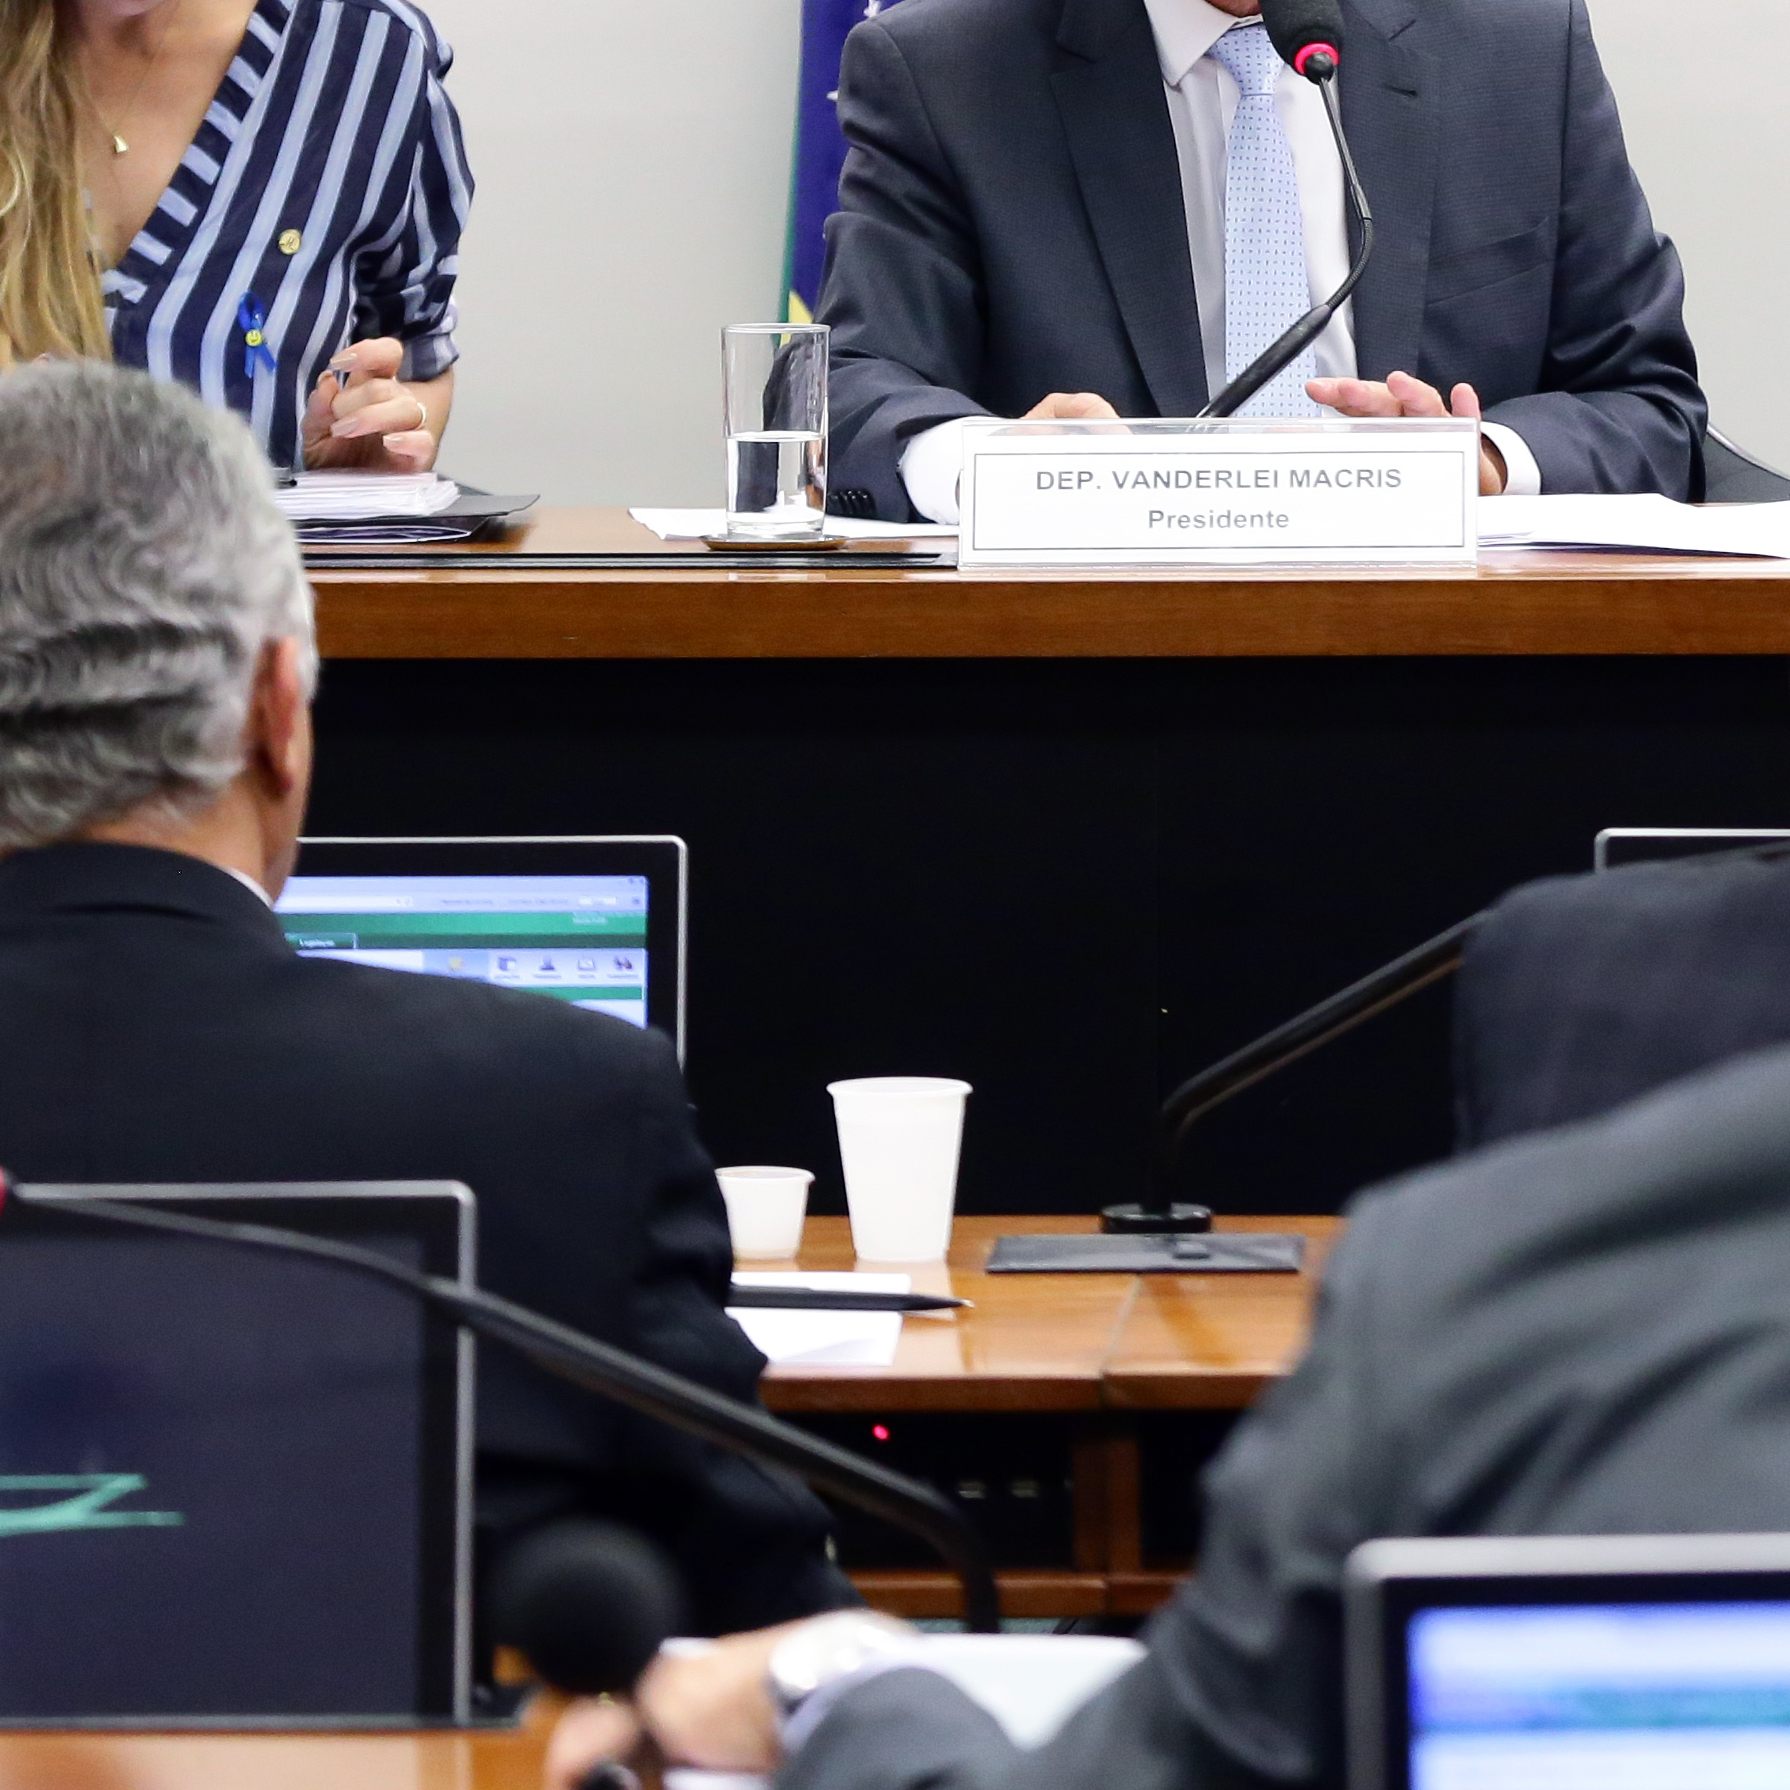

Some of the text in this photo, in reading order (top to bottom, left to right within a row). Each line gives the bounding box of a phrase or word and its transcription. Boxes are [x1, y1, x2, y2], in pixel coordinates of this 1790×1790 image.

[1036, 468, 1402, 490] DEP. VANDERLEI MACRIS
[1148, 509, 1290, 529] Presidente
